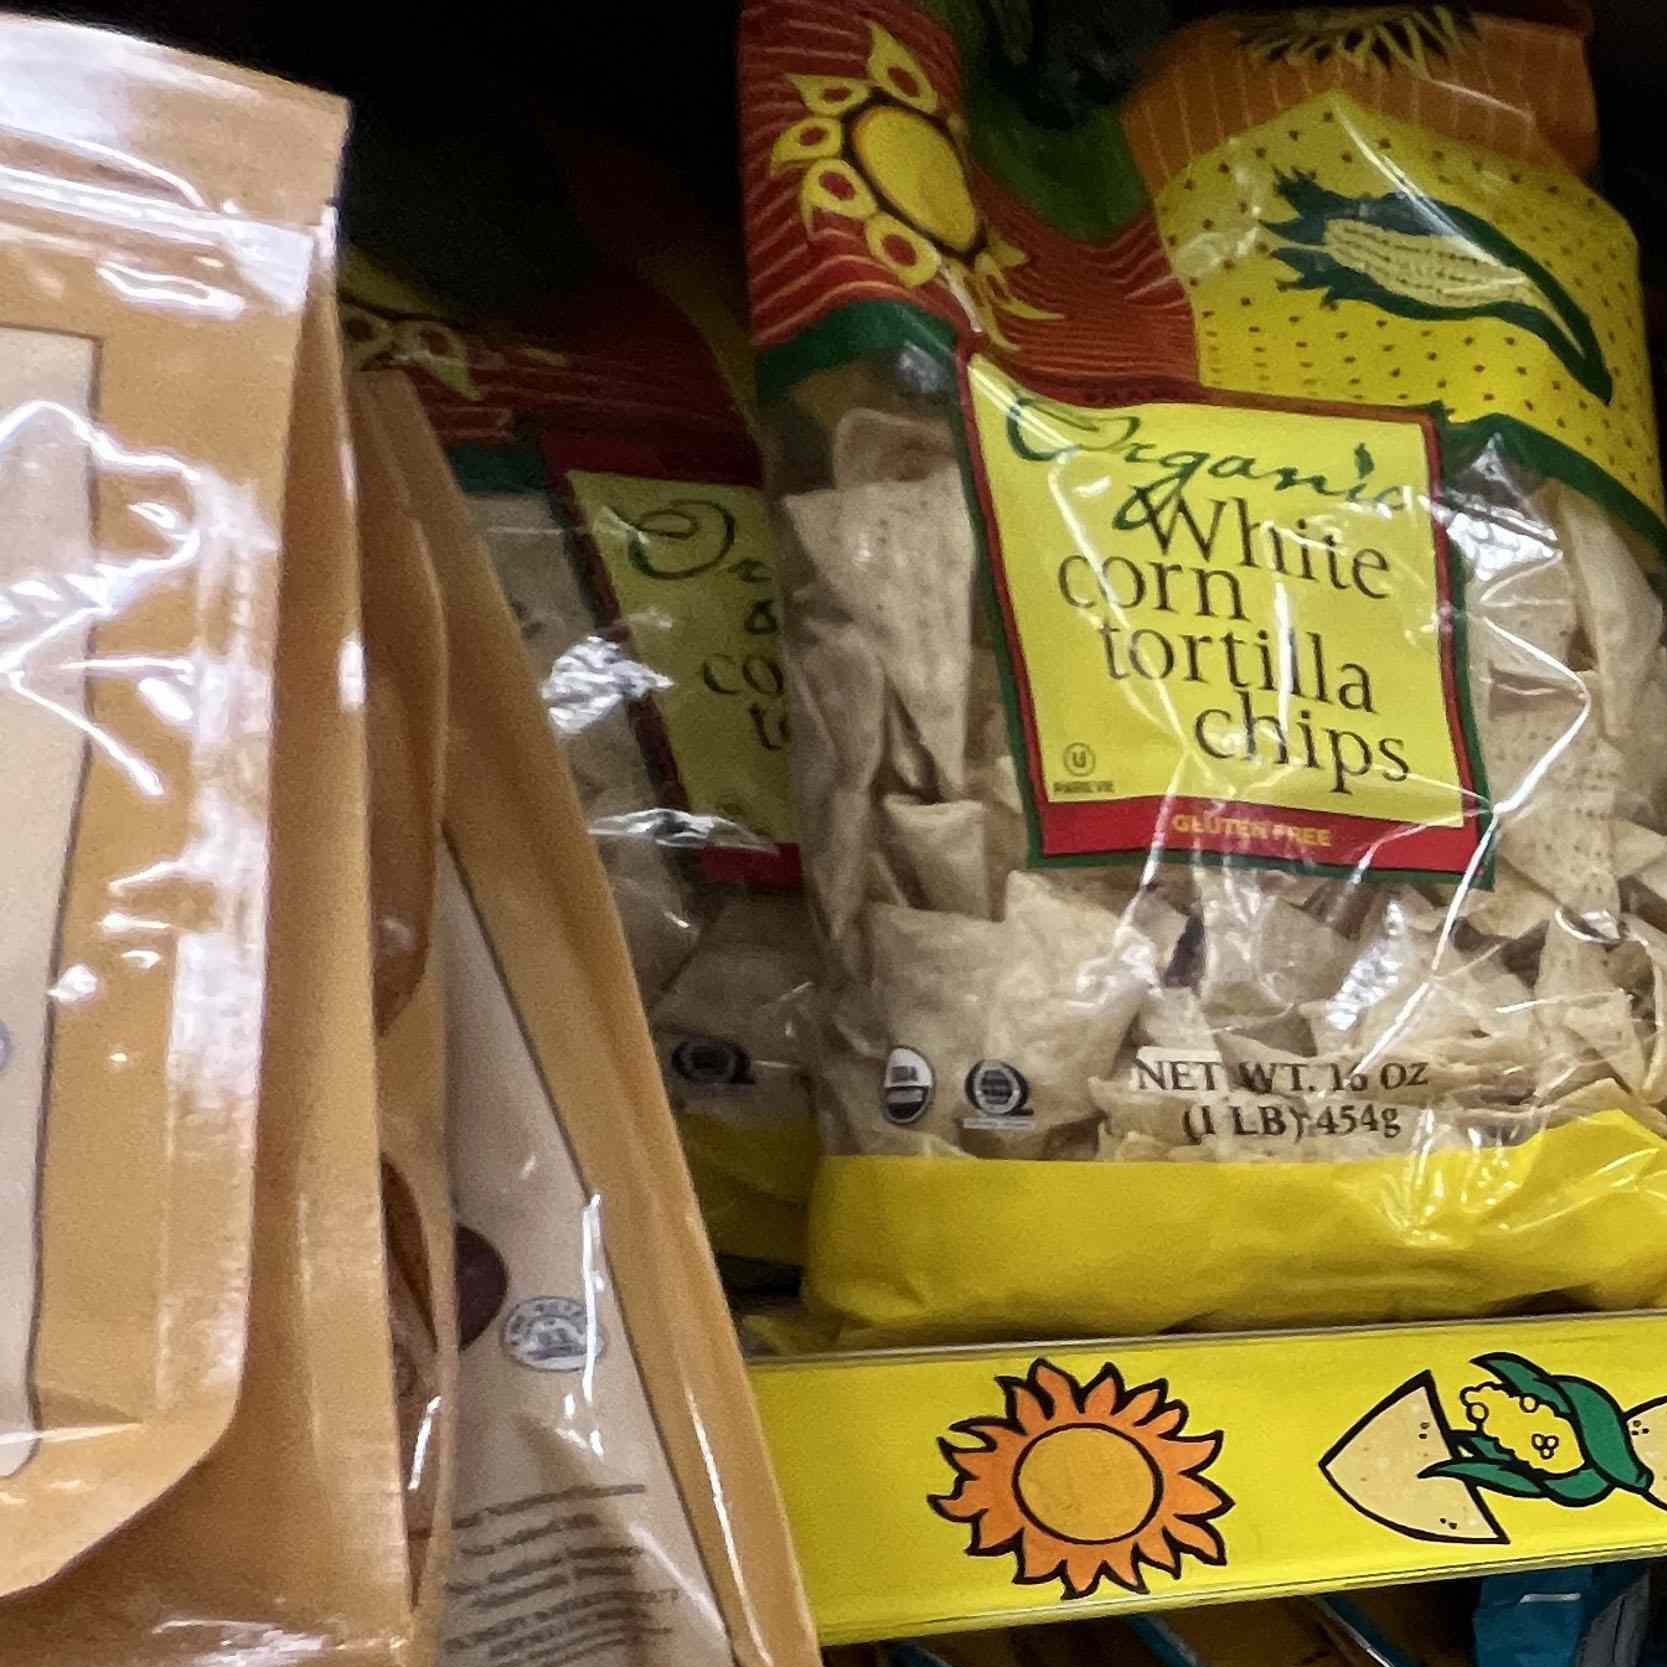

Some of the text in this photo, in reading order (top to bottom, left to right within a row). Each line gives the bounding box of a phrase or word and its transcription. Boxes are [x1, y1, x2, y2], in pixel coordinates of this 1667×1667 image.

[1007, 397, 1411, 530] Organic
[1057, 554, 1248, 620] corn
[1136, 490, 1390, 600] White
[1100, 617, 1379, 714] tortilla
[1194, 691, 1411, 794] chips
[1135, 1057, 1218, 1094] NET
[1235, 1059, 1321, 1095] WT.
[1377, 1058, 1432, 1091] OZ
[1314, 1104, 1403, 1142] 454g
